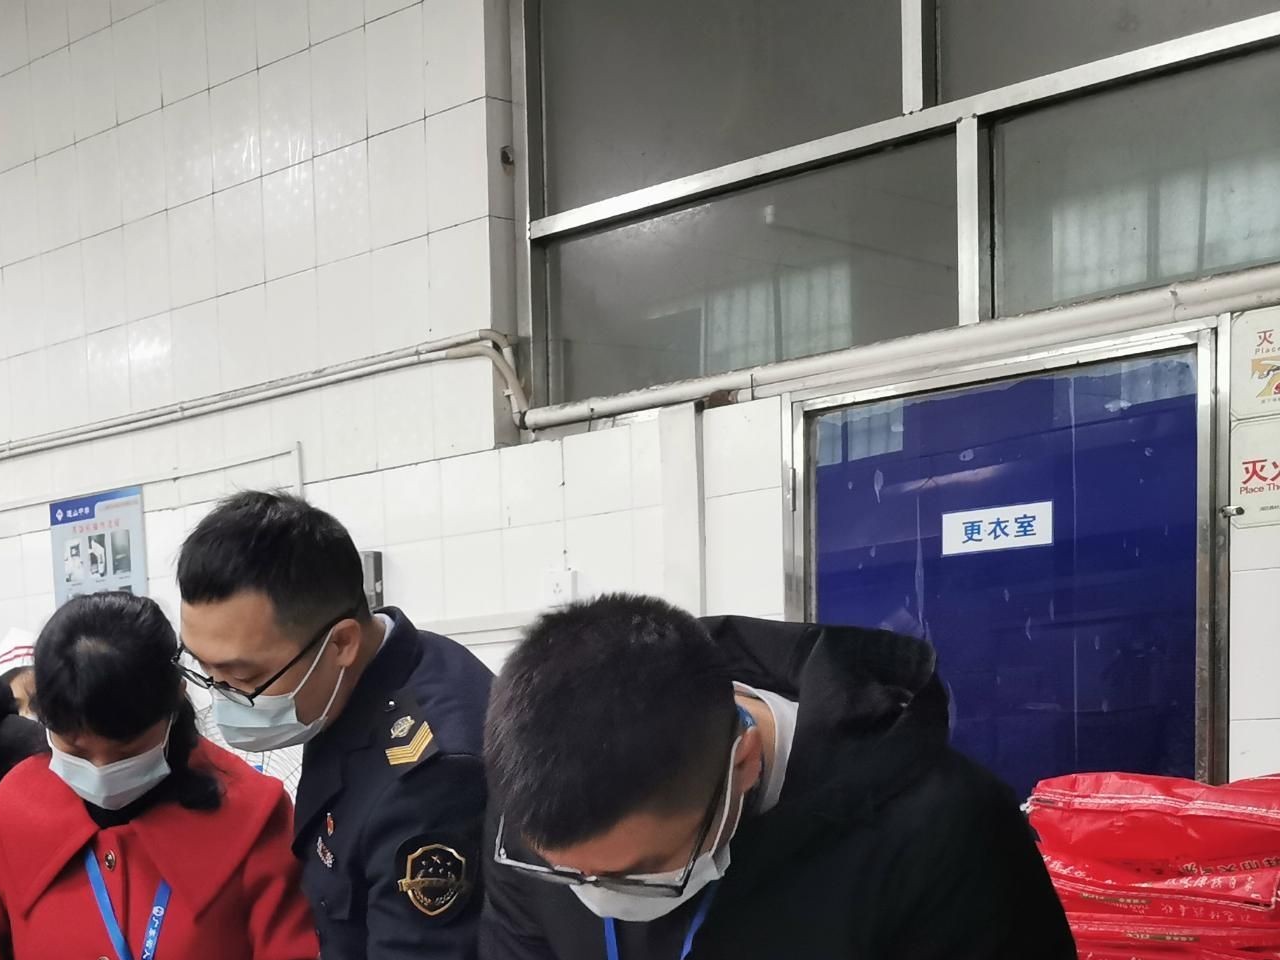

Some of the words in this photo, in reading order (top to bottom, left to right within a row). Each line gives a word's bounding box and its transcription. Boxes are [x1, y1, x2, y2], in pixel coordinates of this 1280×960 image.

[1240, 486, 1265, 495] Place
[962, 514, 1037, 544] 更衣室
